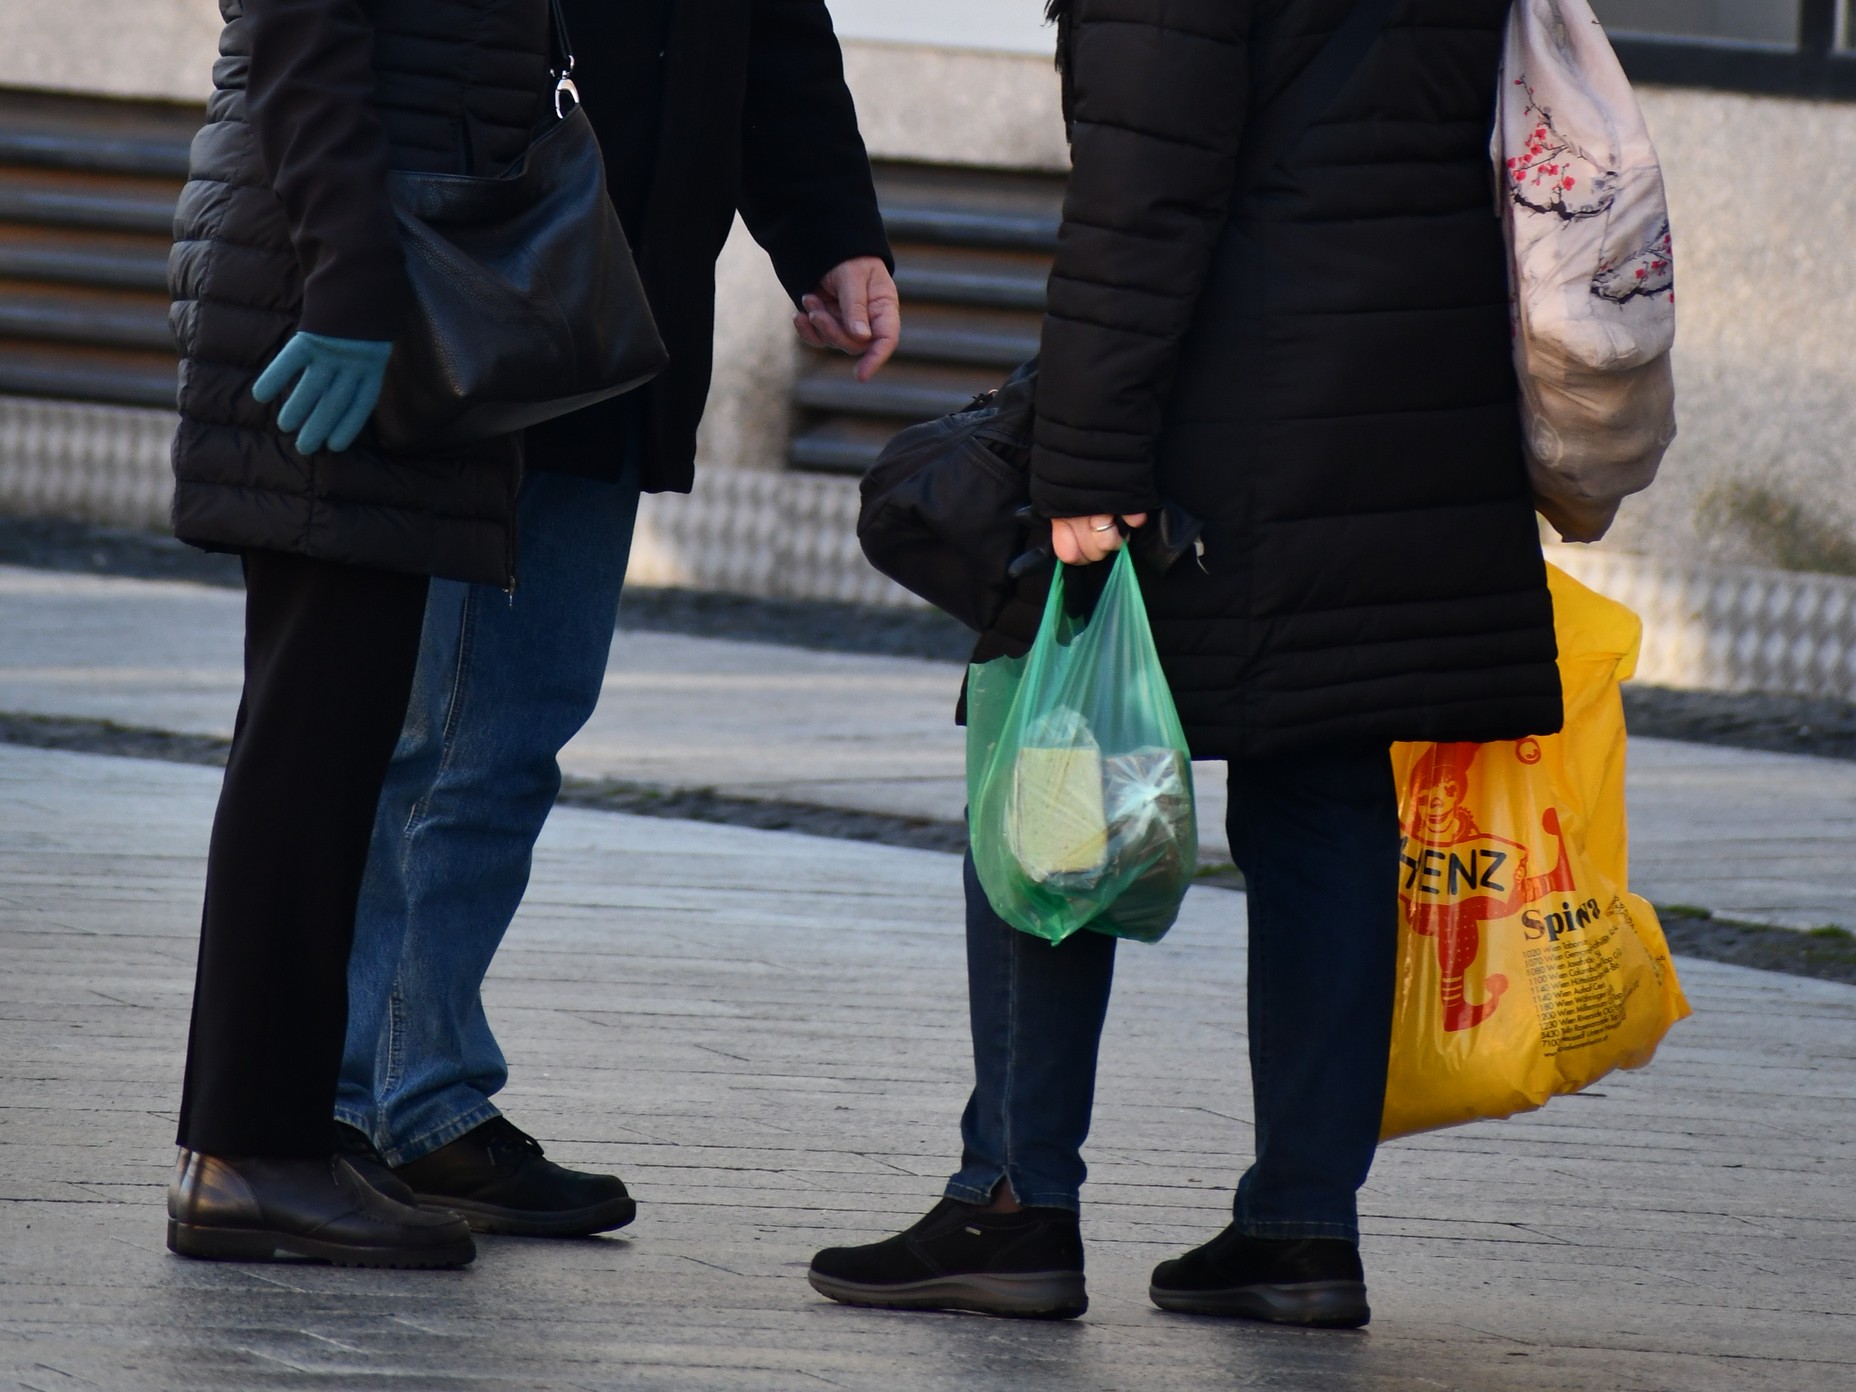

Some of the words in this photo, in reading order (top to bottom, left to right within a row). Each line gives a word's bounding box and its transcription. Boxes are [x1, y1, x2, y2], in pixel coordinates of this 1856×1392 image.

[1554, 988, 1573, 999] Wien
[1555, 997, 1574, 1008] Wien
[1558, 1007, 1577, 1018] Wien
